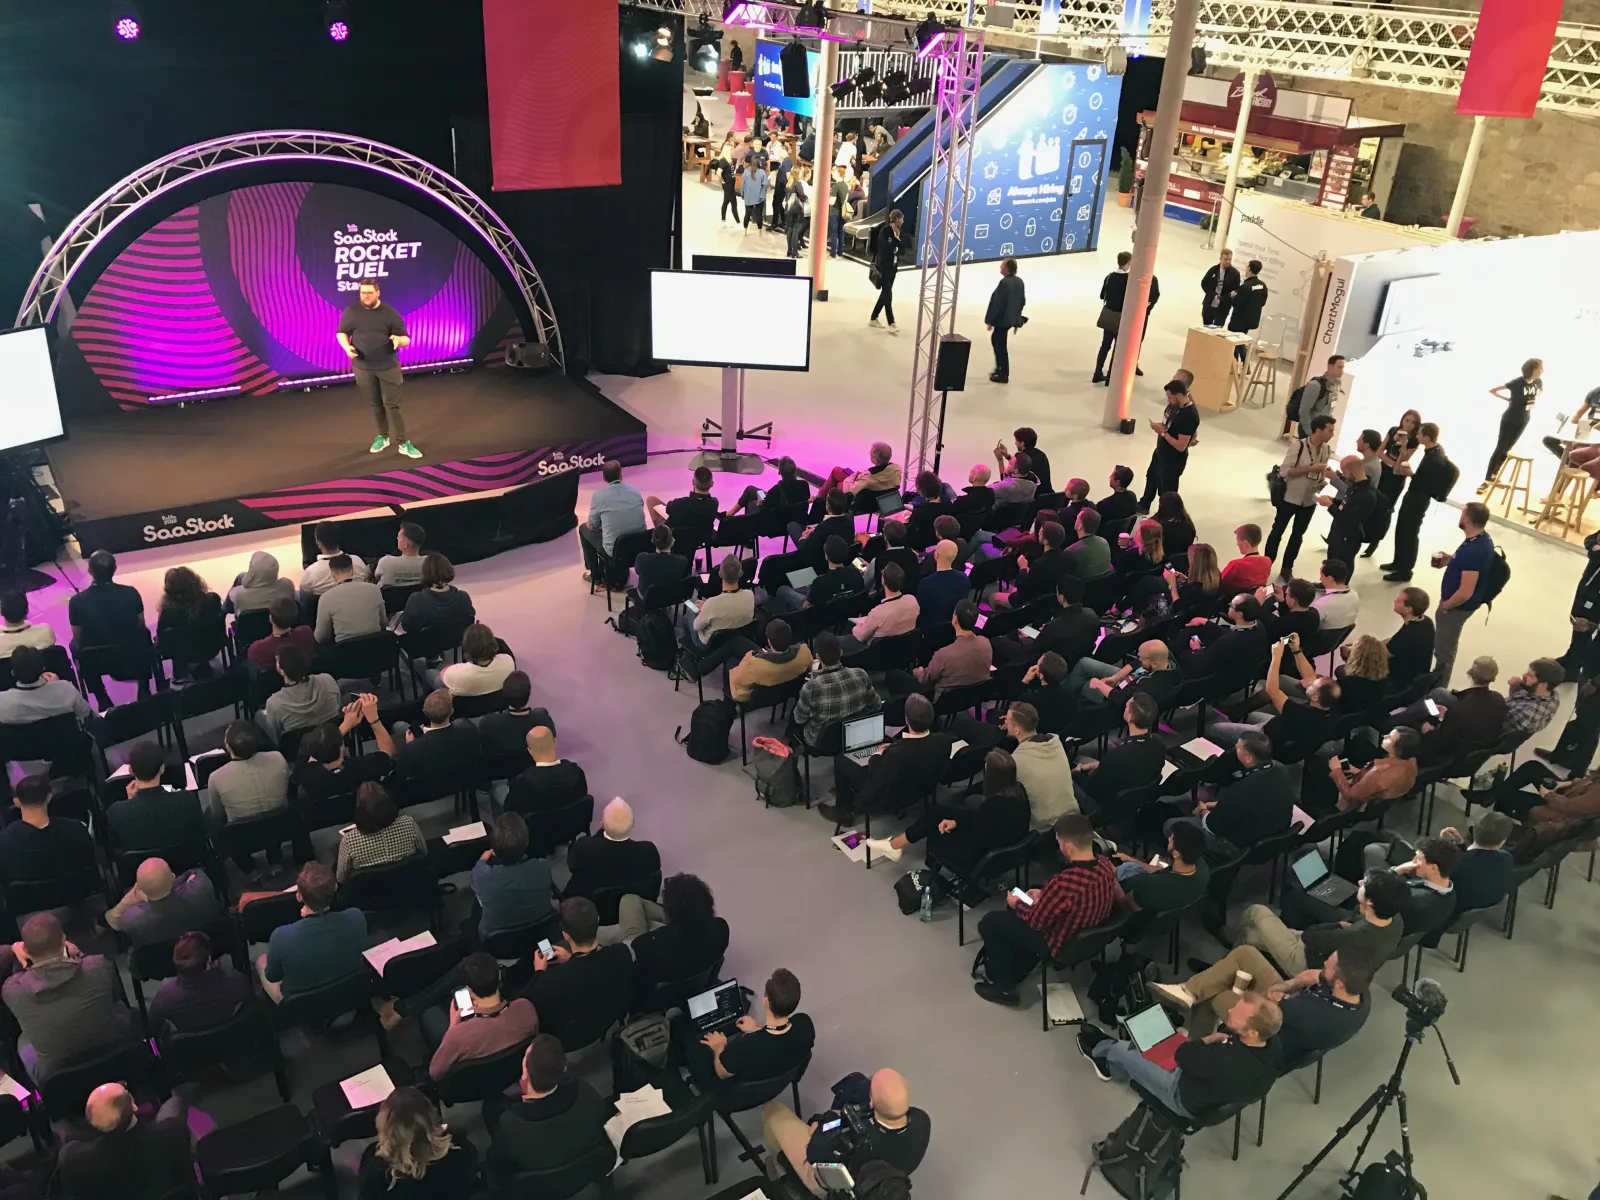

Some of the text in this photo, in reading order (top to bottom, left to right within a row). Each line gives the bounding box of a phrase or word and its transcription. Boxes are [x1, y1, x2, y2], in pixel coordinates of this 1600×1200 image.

[1007, 183, 1065, 197] Always Hiring
[1240, 214, 1264, 226] paddle
[334, 229, 398, 245] SaaStock
[334, 242, 422, 263] ROCKET
[336, 261, 389, 280] FUEL
[337, 280, 361, 292] Sta
[1322, 278, 1346, 345] ChartMogul
[538, 453, 606, 476] SaaStock
[143, 514, 235, 542] SaaStock
